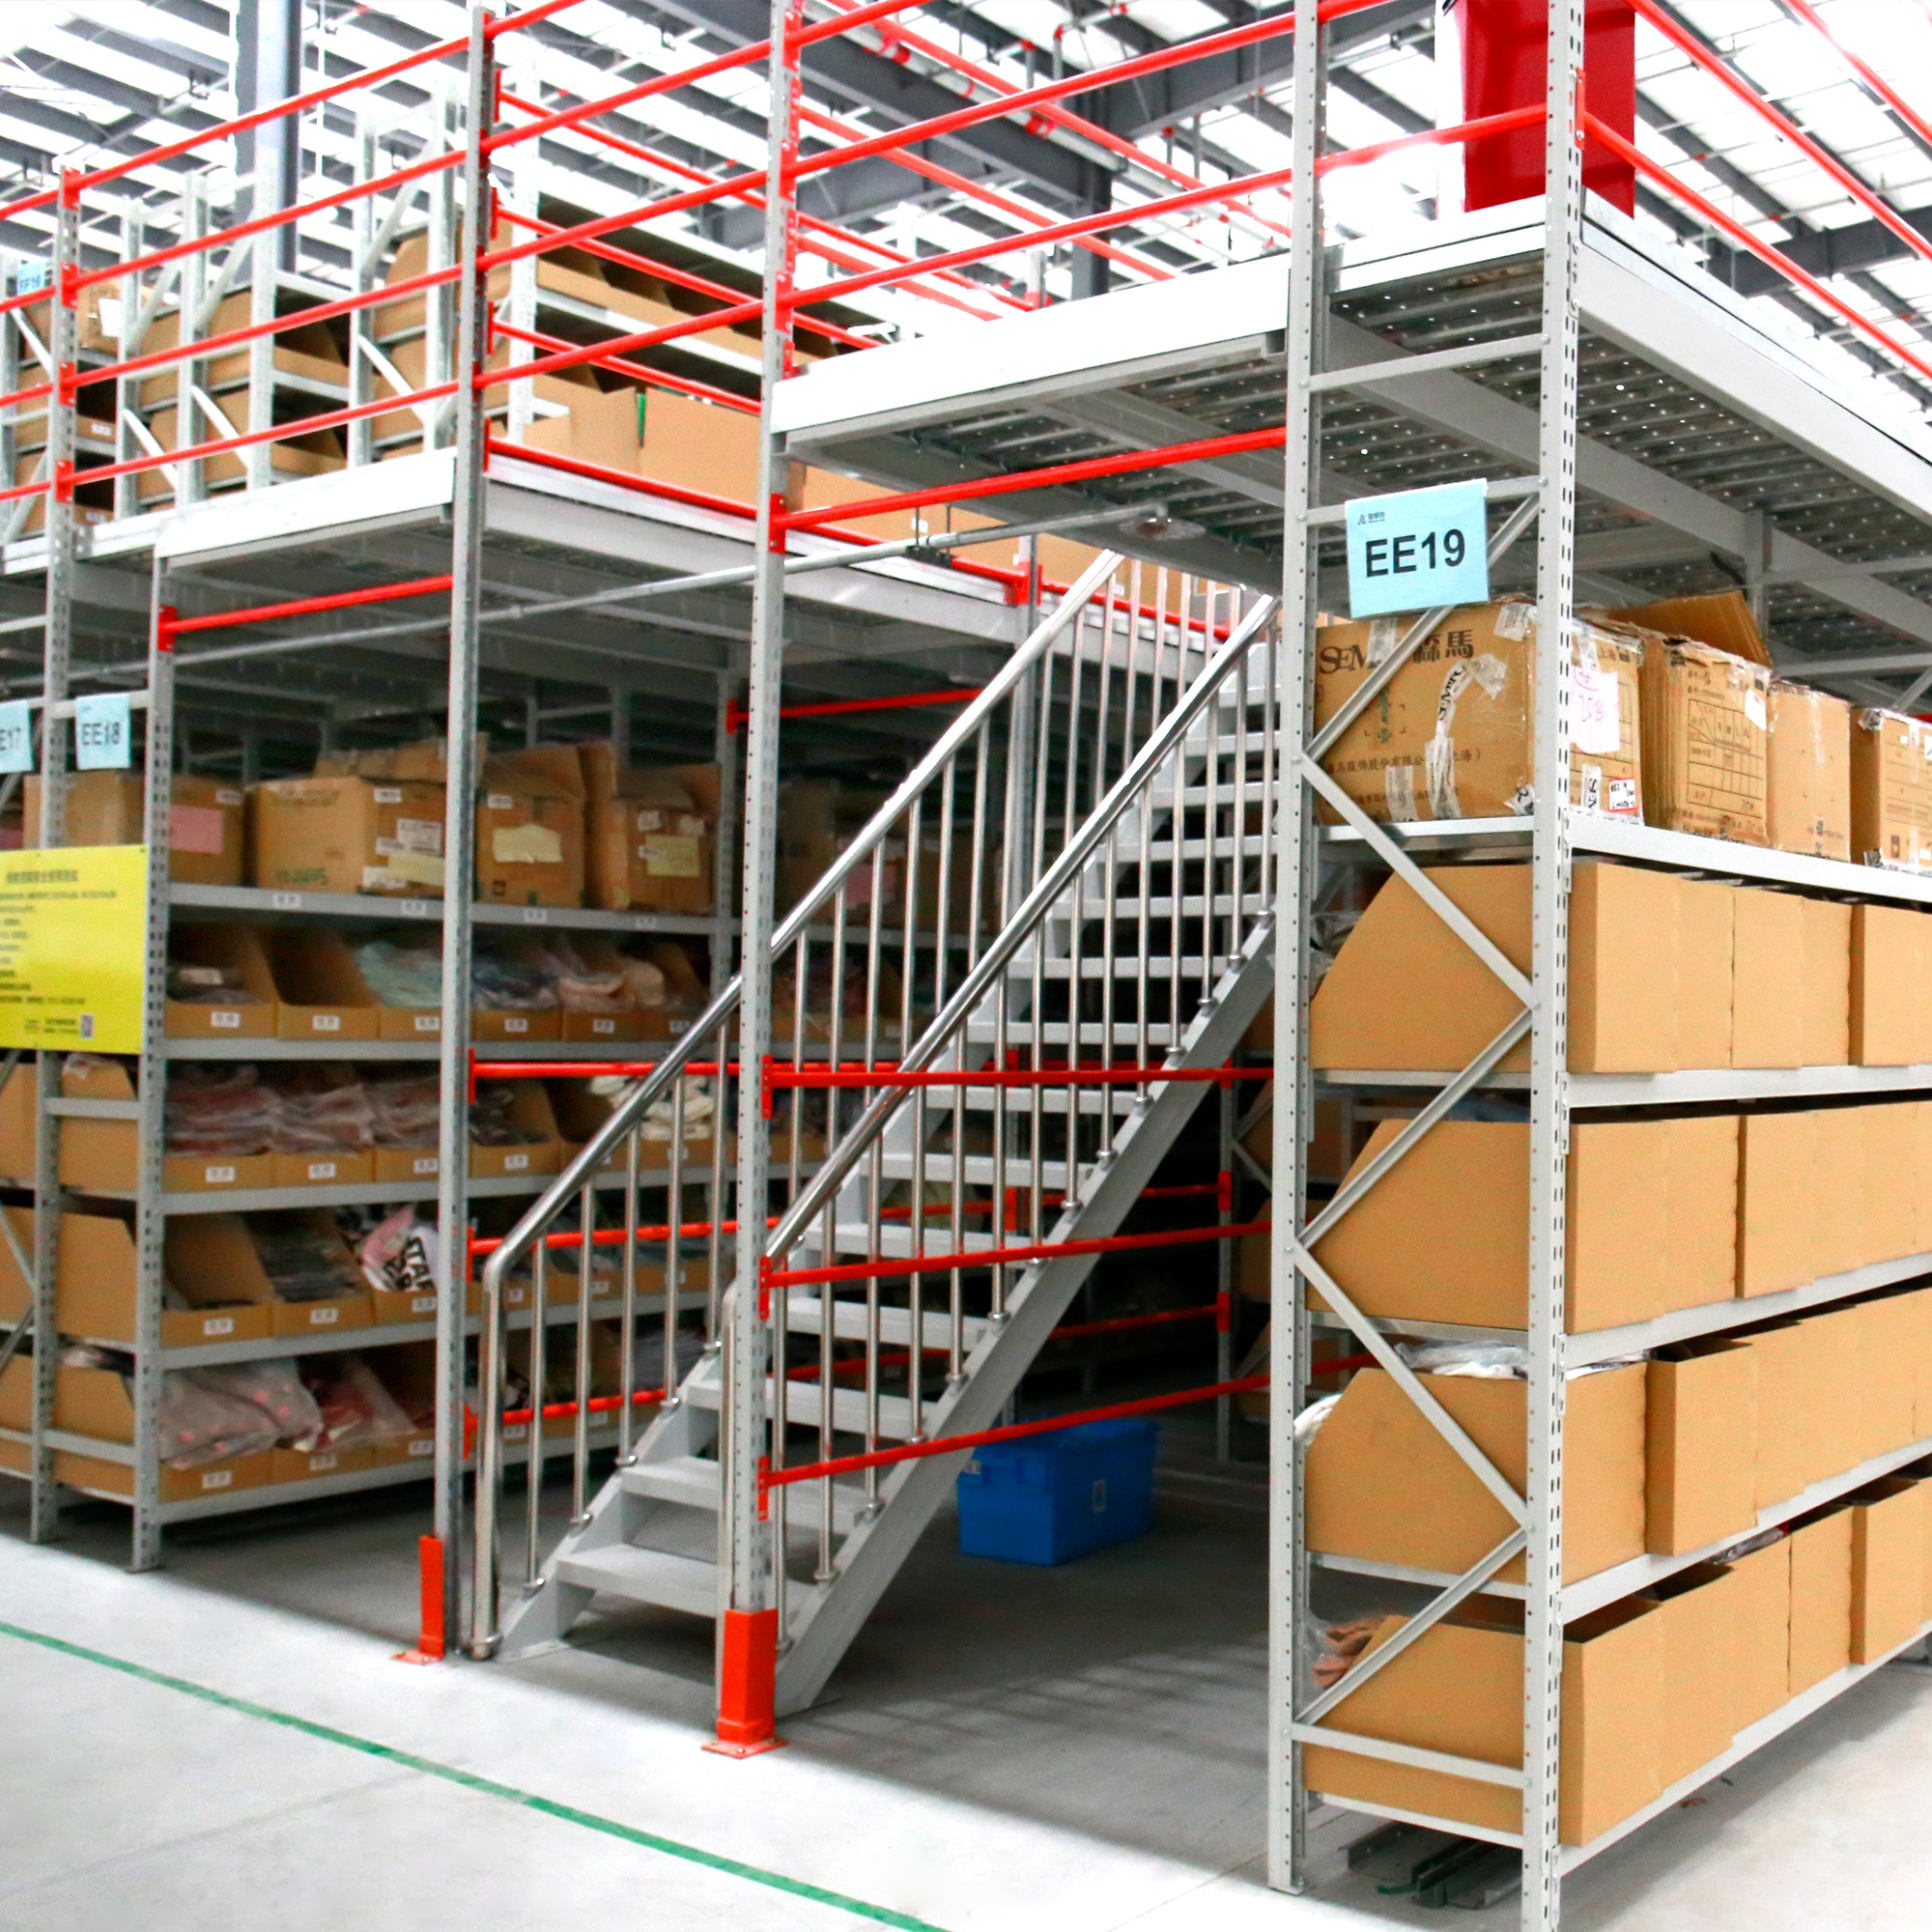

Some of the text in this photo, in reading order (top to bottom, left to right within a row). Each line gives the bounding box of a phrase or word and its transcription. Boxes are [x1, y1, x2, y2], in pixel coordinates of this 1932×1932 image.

[1366, 528, 1465, 578] EE19
[1319, 643, 1381, 674] SEM
[81, 722, 121, 746] EE18
